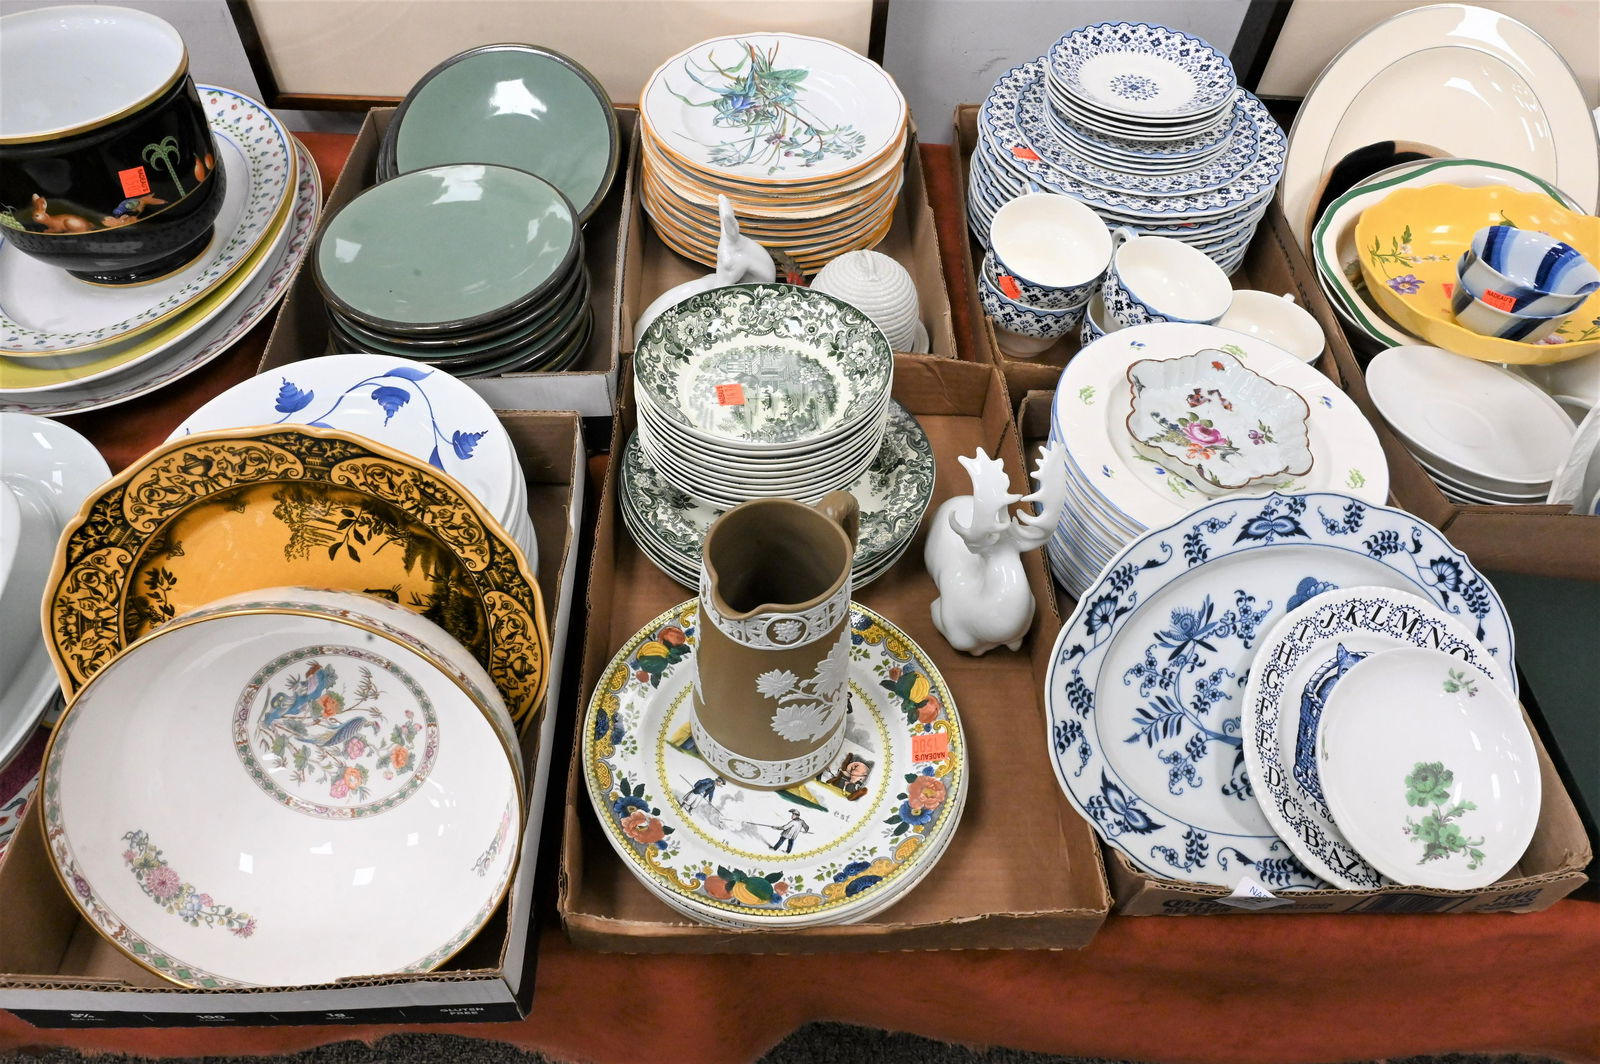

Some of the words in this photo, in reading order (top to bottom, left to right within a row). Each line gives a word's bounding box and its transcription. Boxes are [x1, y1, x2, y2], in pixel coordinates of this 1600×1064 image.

[1486, 289, 1513, 304] NADEAU'S
[1319, 611, 1336, 628] J
[1343, 602, 1363, 627] K
[1370, 604, 1385, 627] L
[1393, 610, 1420, 634] M
[1297, 624, 1310, 643] I
[1421, 624, 1449, 649] N
[1277, 641, 1294, 665] H
[1266, 668, 1280, 690] G
[1260, 696, 1273, 715] F
[1260, 728, 1272, 751] E
[914, 751, 946, 762] NADEAU'S
[1265, 764, 1281, 786] D
[1283, 798, 1296, 819] C
[1296, 785, 1309, 800] IN
[1309, 802, 1318, 811] A
[1303, 823, 1319, 847] B
[1327, 848, 1347, 870] A
